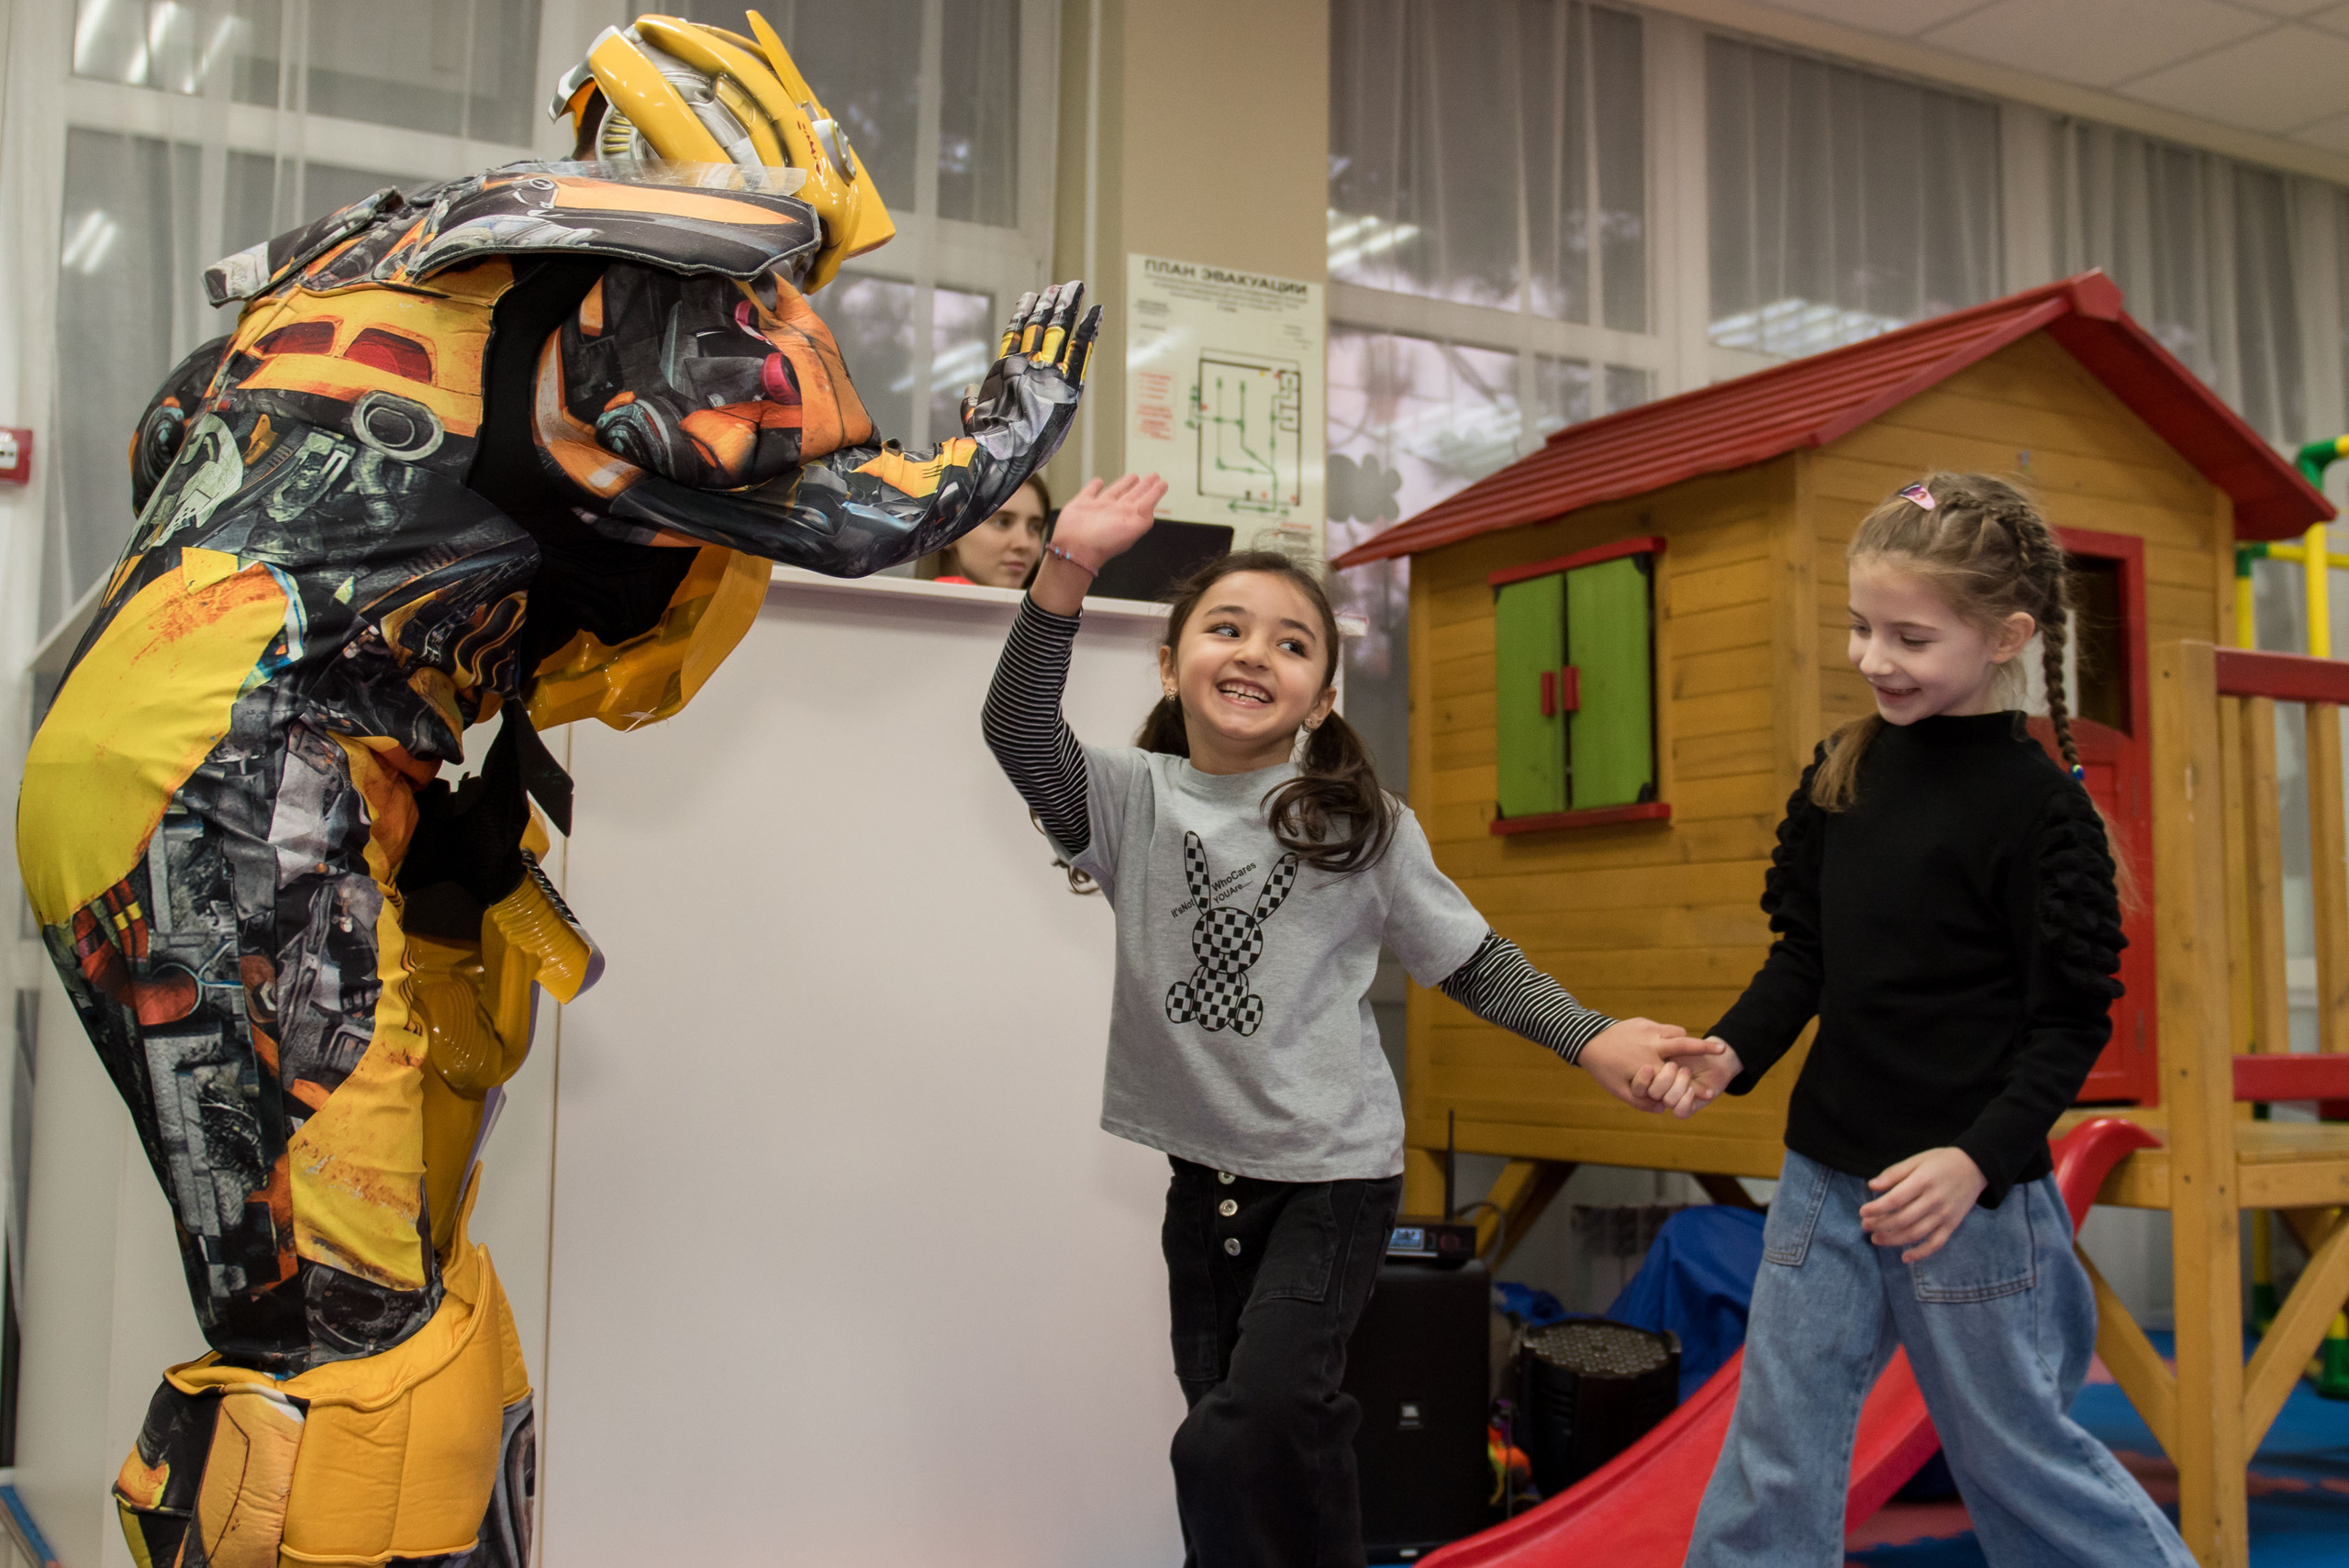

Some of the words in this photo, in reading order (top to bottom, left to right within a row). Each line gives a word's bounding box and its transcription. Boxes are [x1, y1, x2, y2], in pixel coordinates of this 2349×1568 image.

[1145, 259, 1195, 276] ПЛАН
[1201, 269, 1308, 294] ЭВАКУАЦИИ
[1170, 898, 1196, 918] It'sNot
[1211, 862, 1257, 892] WhoCares
